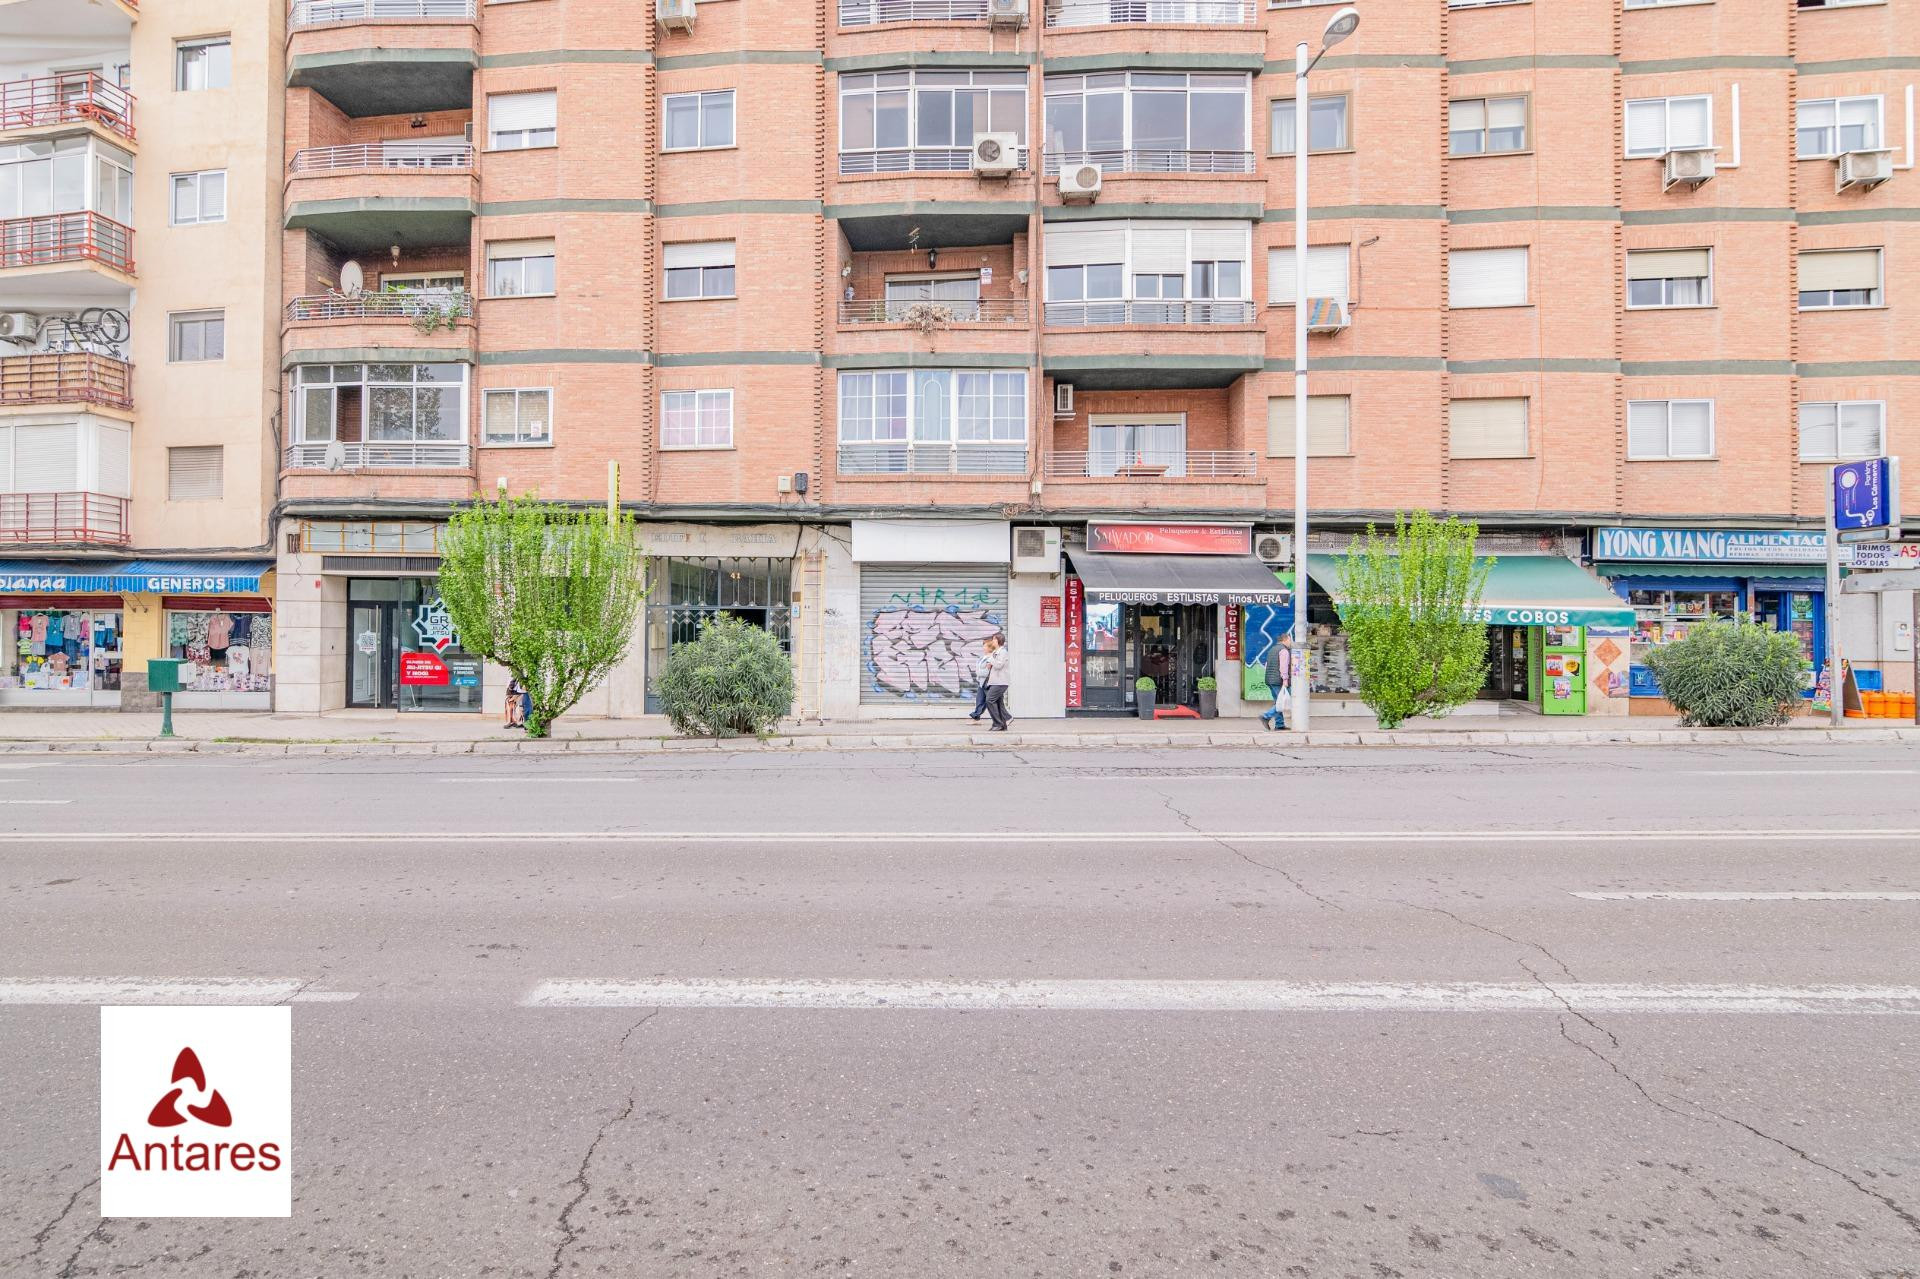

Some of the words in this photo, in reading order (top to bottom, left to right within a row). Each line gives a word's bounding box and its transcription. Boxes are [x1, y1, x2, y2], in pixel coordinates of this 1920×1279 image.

[1094, 527, 1154, 550] SALVADOR
[1601, 530, 1657, 557] YONG
[1661, 531, 1725, 558] XIANG
[729, 572, 741, 580] 41
[147, 577, 226, 590] GENEROS
[1099, 593, 1158, 601] PELUQUEROS
[1167, 593, 1219, 602] ESTILISTAS
[430, 616, 449, 624] GR
[1068, 580, 1078, 648] ESTILISTA
[1507, 610, 1569, 624] COBOS
[1068, 658, 1078, 705] UNISEX
